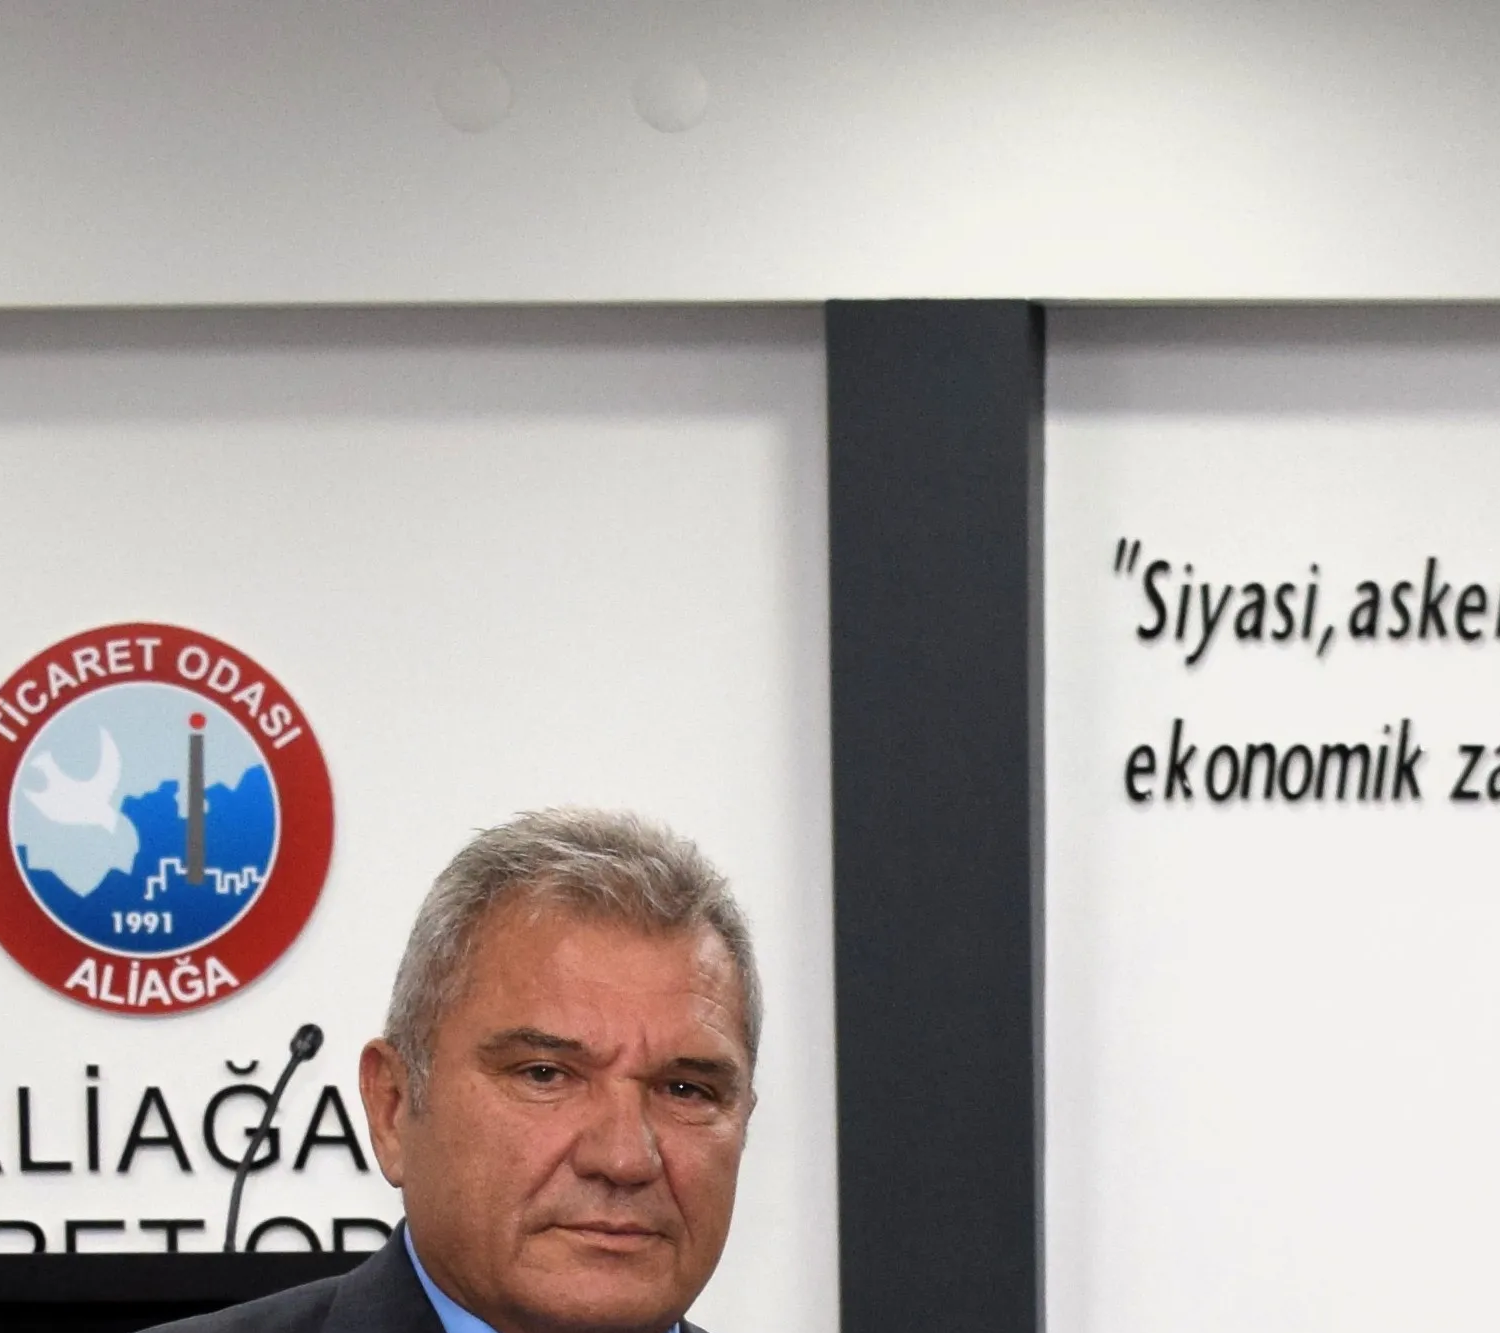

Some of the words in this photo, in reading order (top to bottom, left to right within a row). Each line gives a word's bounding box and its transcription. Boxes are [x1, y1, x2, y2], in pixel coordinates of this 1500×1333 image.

[176, 646, 302, 749] ODASI
[1123, 717, 1424, 805] ekonomik
[111, 910, 173, 934] 1991
[63, 955, 240, 1007] ALİAĞA
